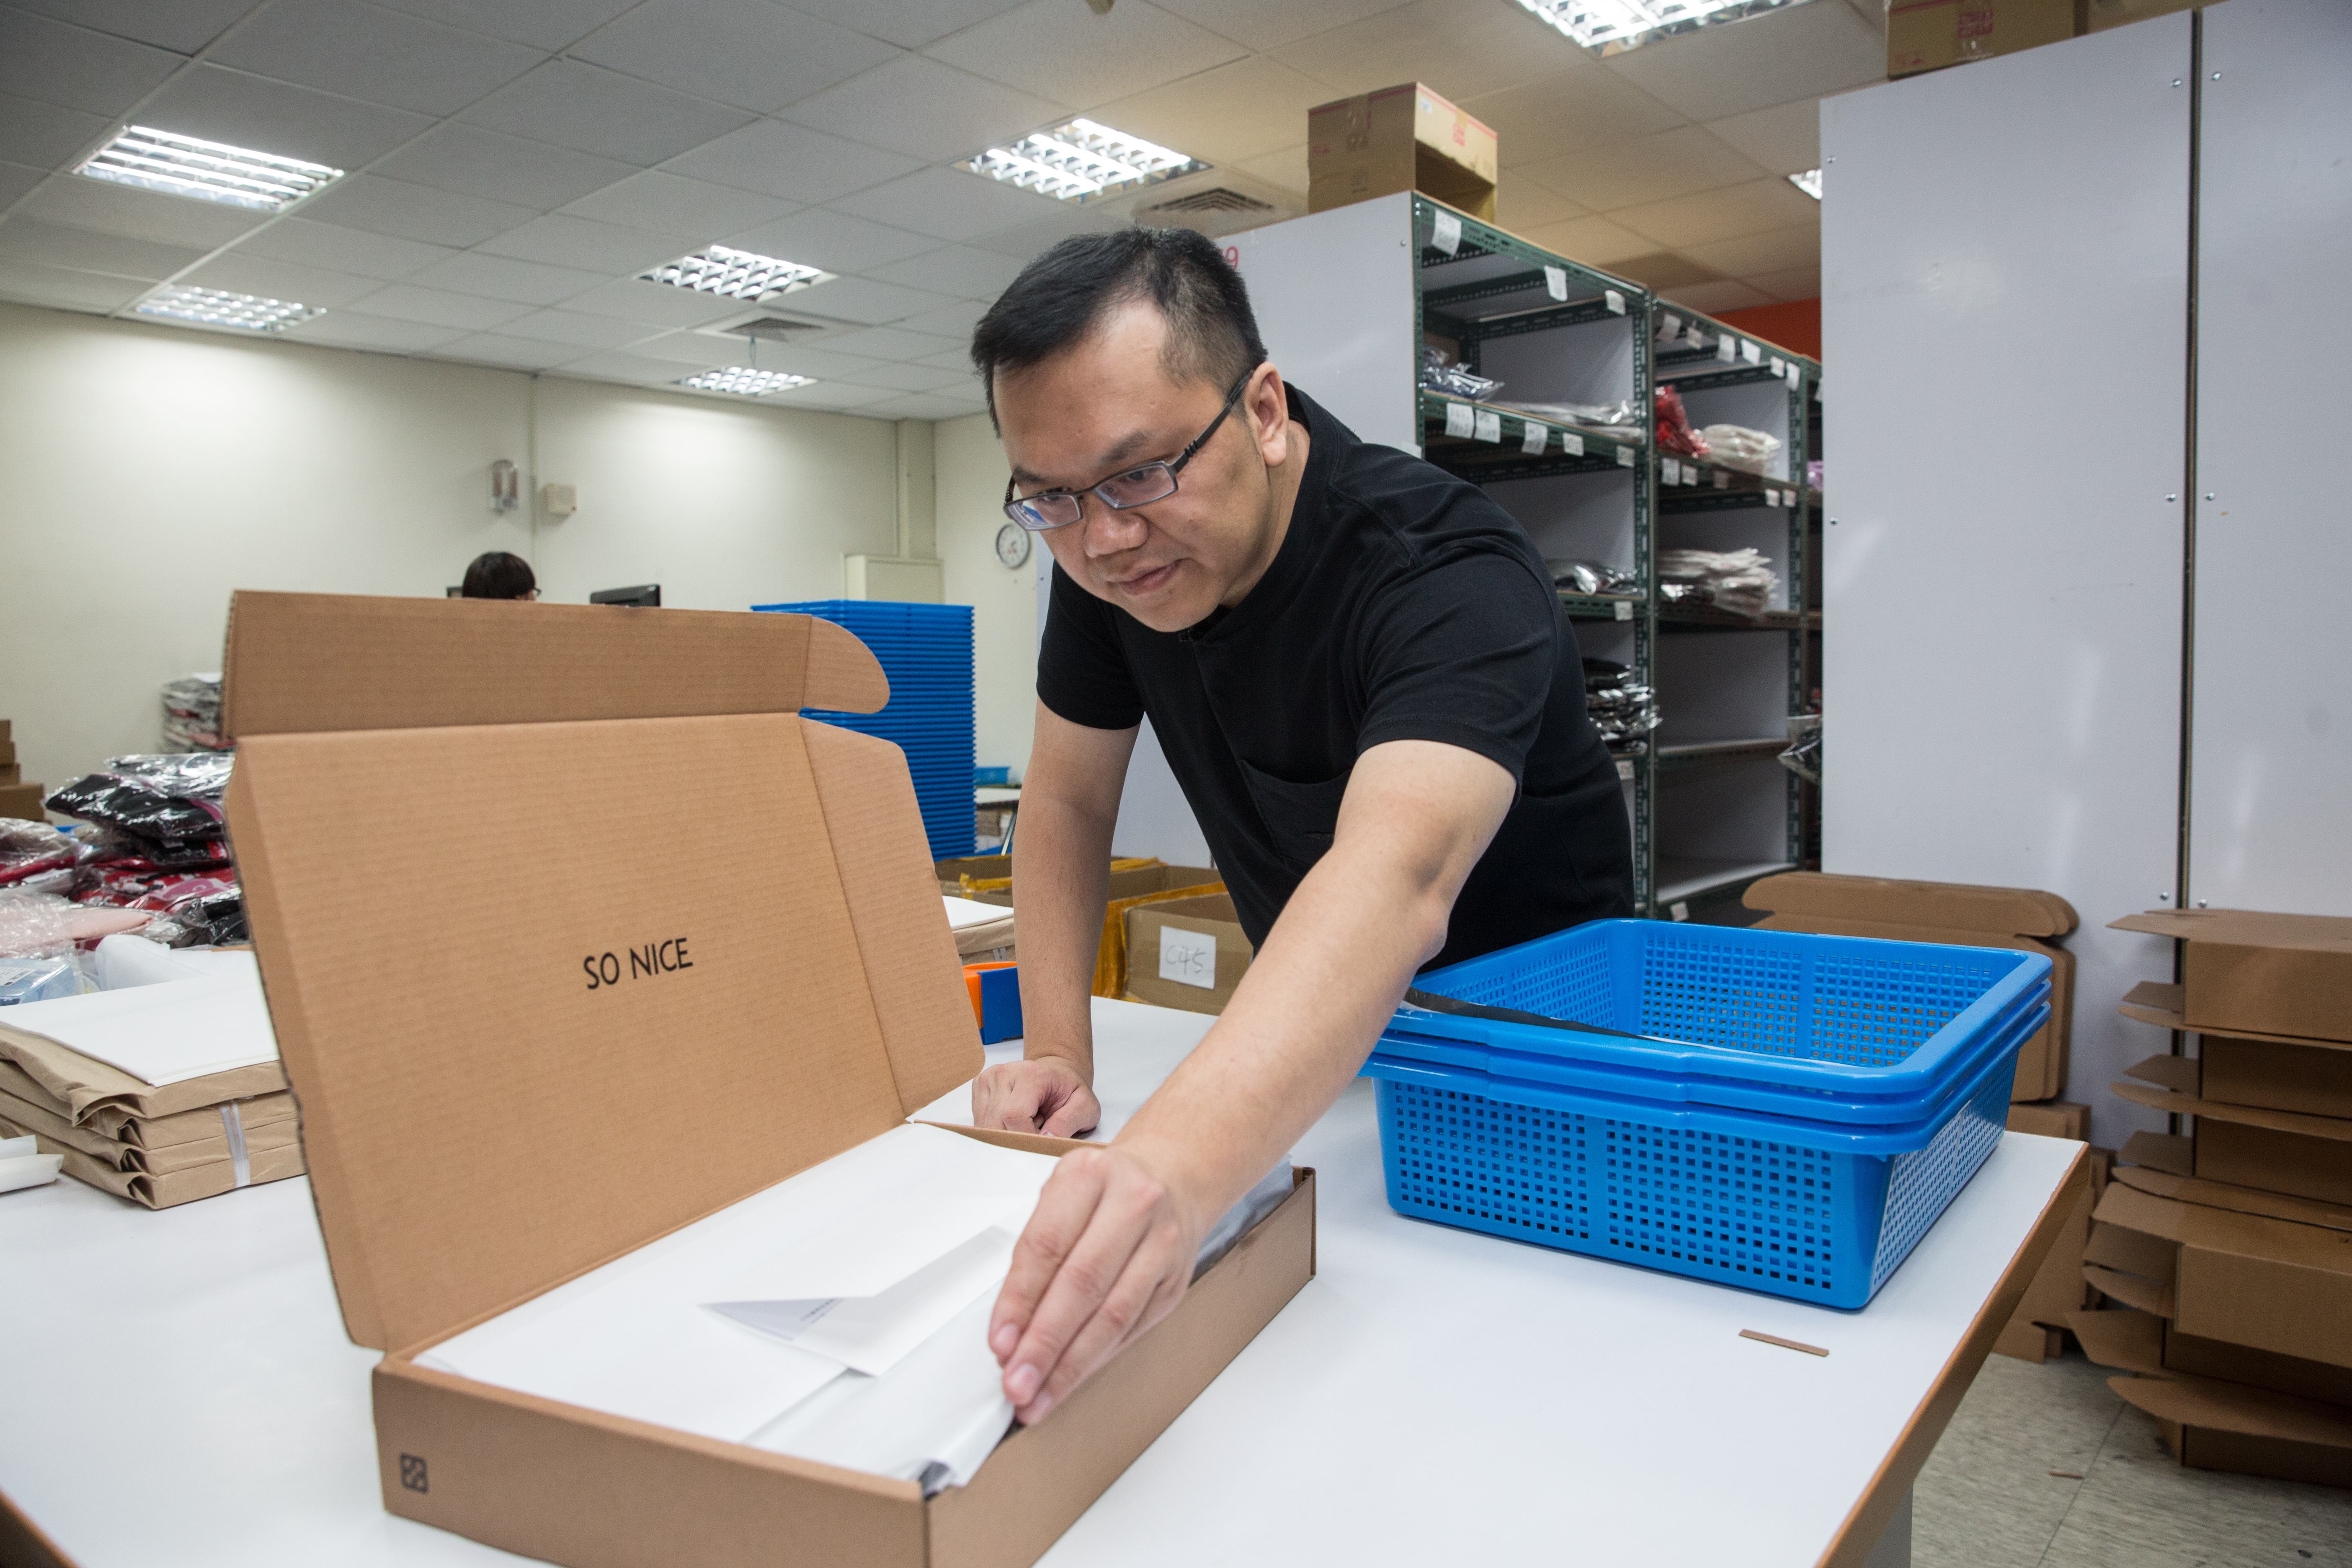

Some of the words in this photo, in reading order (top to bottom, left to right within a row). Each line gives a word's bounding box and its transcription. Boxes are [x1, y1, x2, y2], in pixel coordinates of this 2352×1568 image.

[1221, 245, 1239, 271] 9
[584, 952, 620, 989] SO
[629, 938, 693, 980] NICE
[1166, 944, 1205, 975] C45
